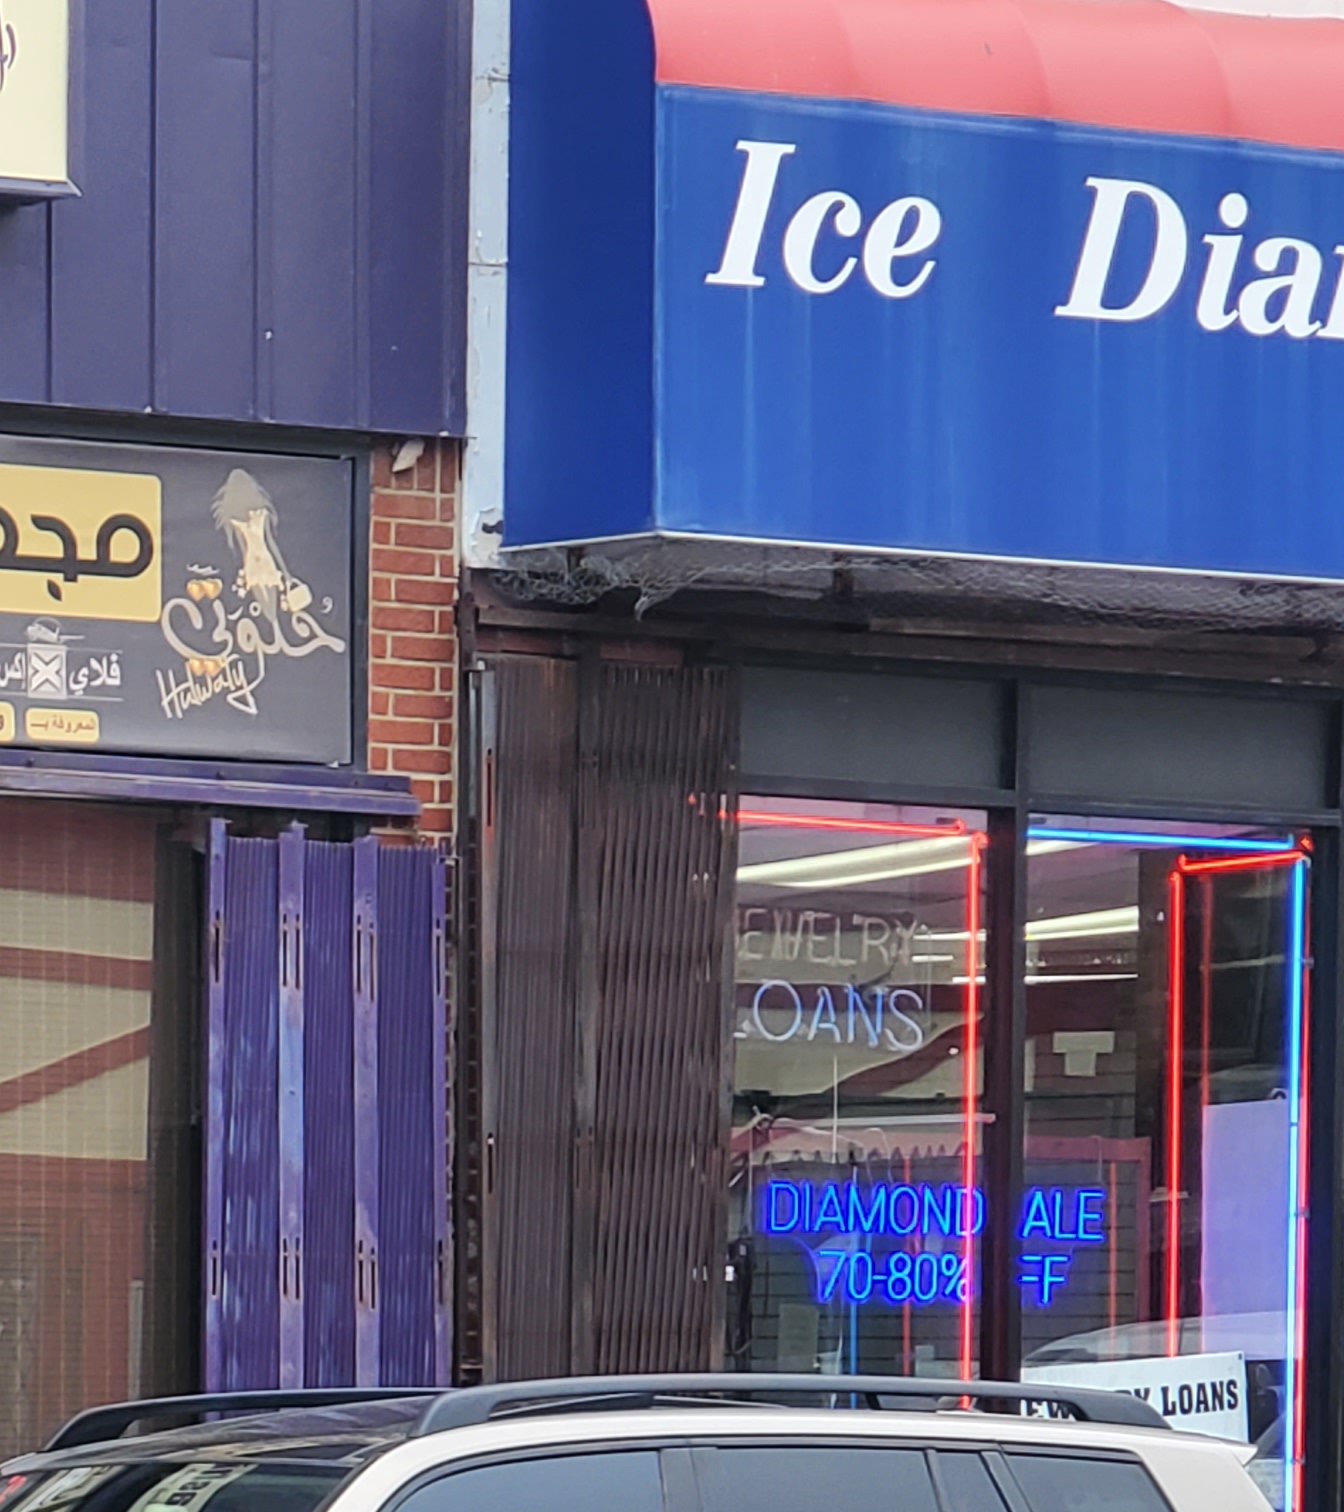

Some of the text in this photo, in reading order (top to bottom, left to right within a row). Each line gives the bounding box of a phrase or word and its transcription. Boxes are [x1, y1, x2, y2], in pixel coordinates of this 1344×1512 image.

[705, 140, 942, 299] Ice
[69, 652, 121, 696] فلاي
[734, 906, 919, 968] EWELRY
[733, 978, 924, 1051] OANS
[769, 1181, 1105, 1241] DIAMOND ALE
[818, 1248, 973, 1302] 70-80%
[1160, 1378, 1240, 1417] LOANS
